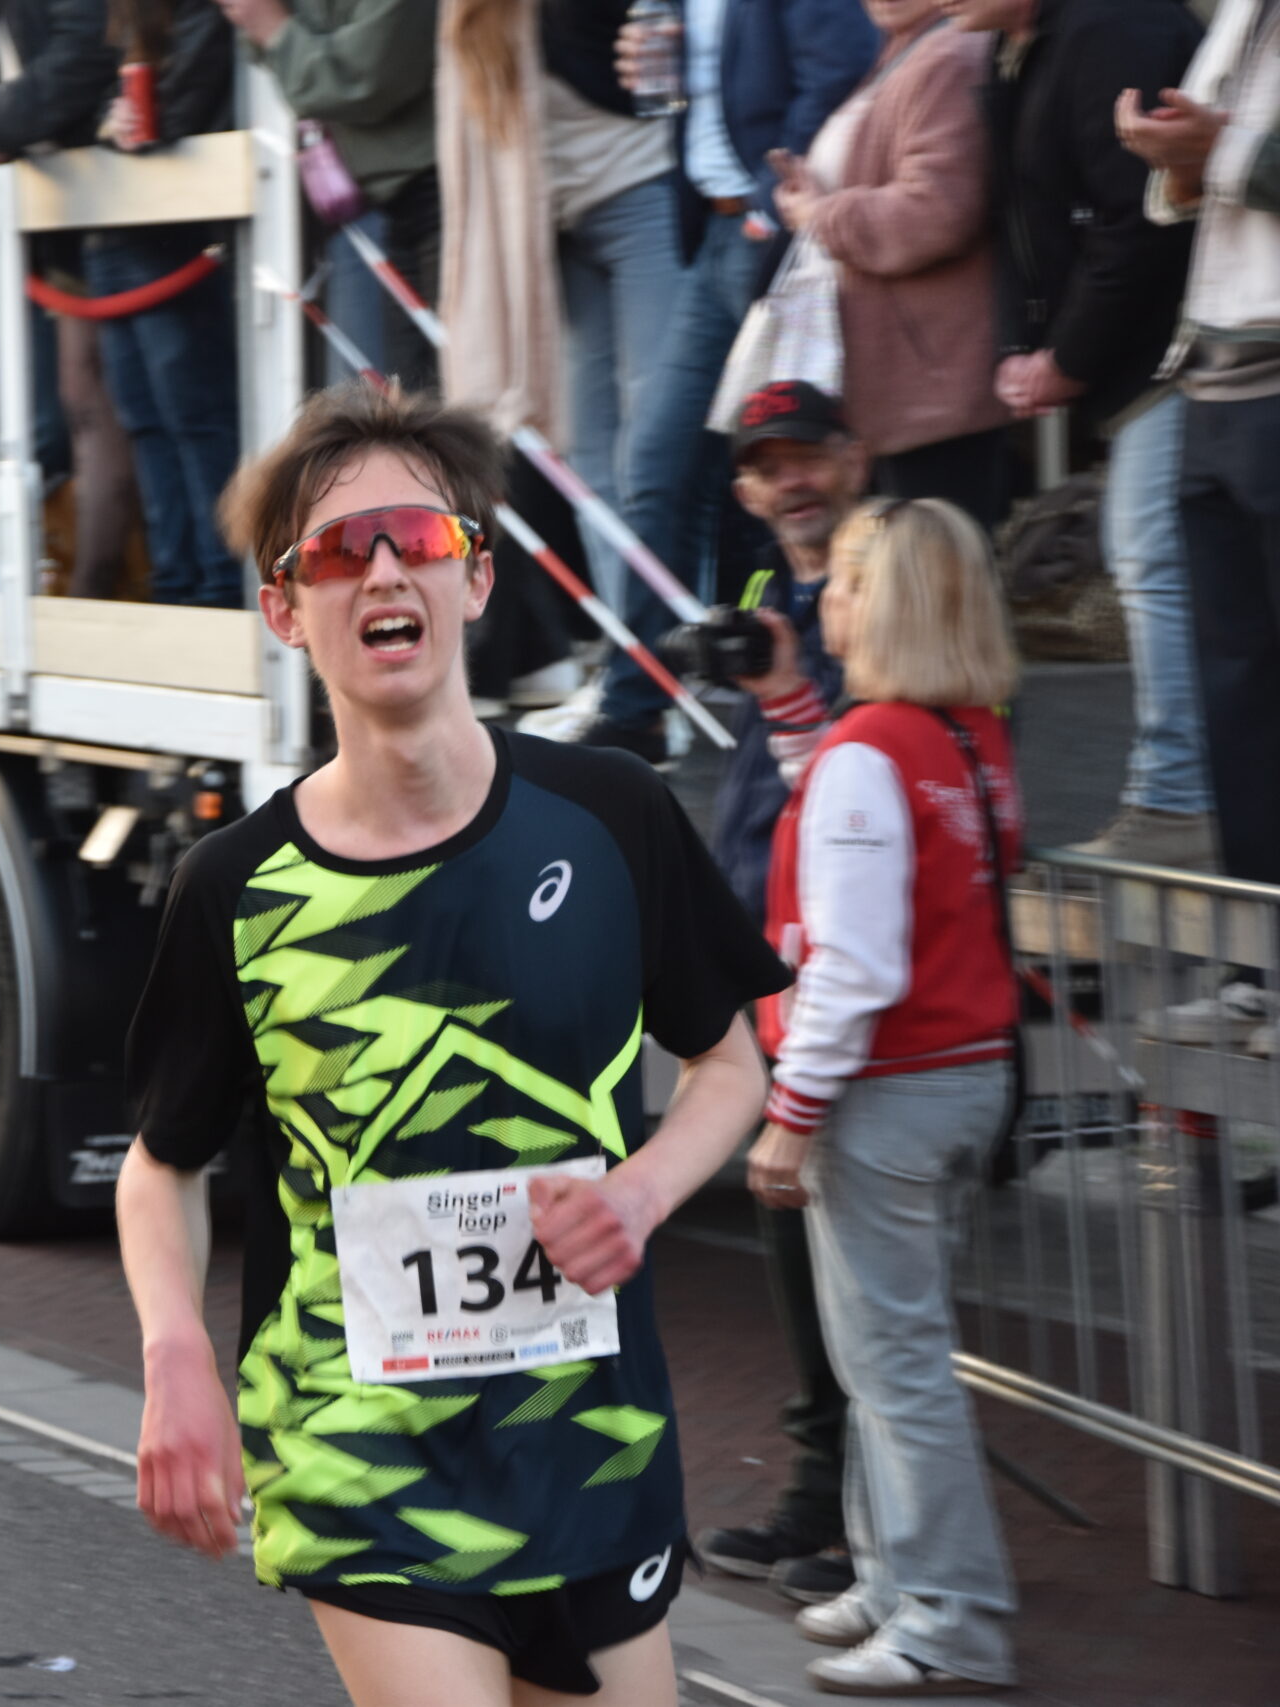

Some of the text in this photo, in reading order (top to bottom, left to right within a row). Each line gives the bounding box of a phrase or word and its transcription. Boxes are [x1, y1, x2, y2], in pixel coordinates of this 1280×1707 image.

[427, 1185, 500, 1213] Singel
[459, 1212, 506, 1234] loop
[402, 1241, 562, 1316] 134
